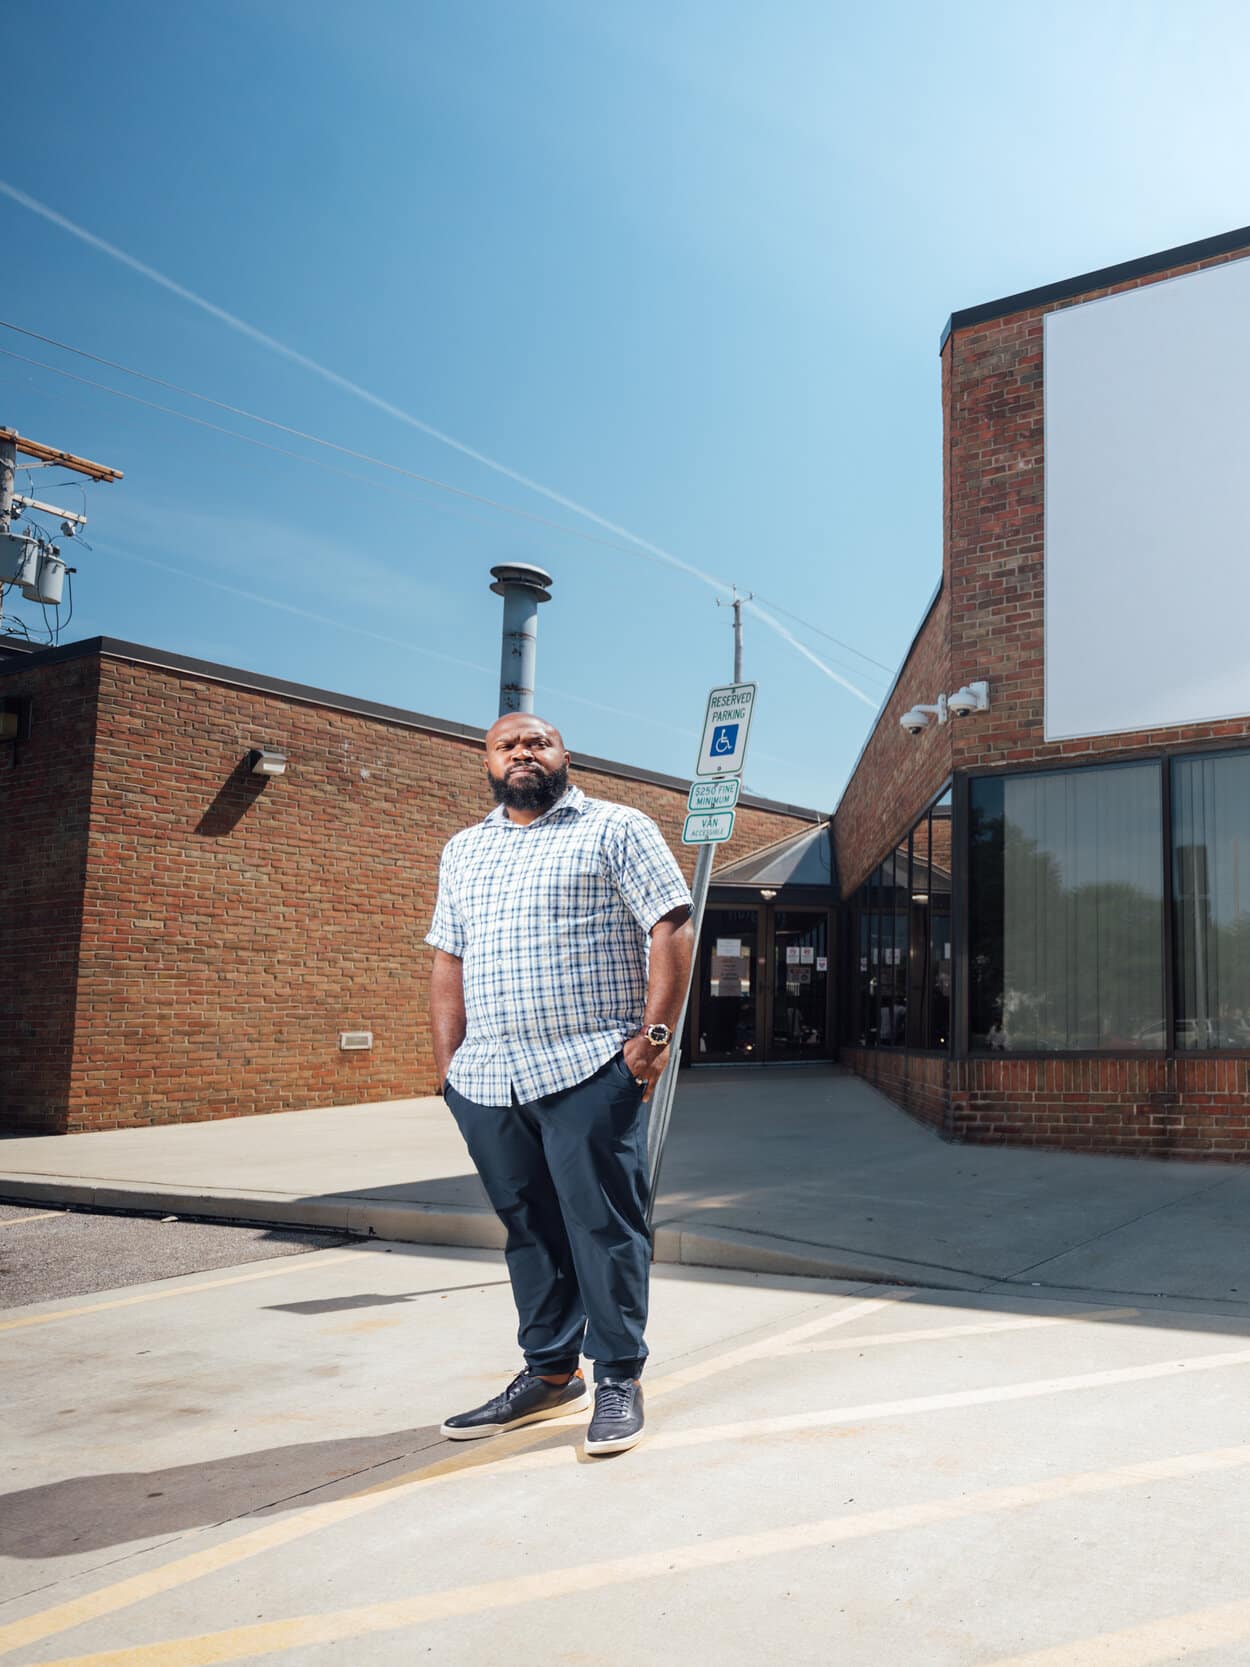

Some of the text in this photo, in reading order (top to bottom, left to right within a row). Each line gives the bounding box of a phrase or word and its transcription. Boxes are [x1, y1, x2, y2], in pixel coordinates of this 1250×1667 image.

[711, 692, 752, 708] RESERVED
[712, 708, 746, 722] PARKING
[718, 783, 736, 793] FINE
[696, 795, 730, 805] MINIMUM
[702, 818, 719, 828] VAN
